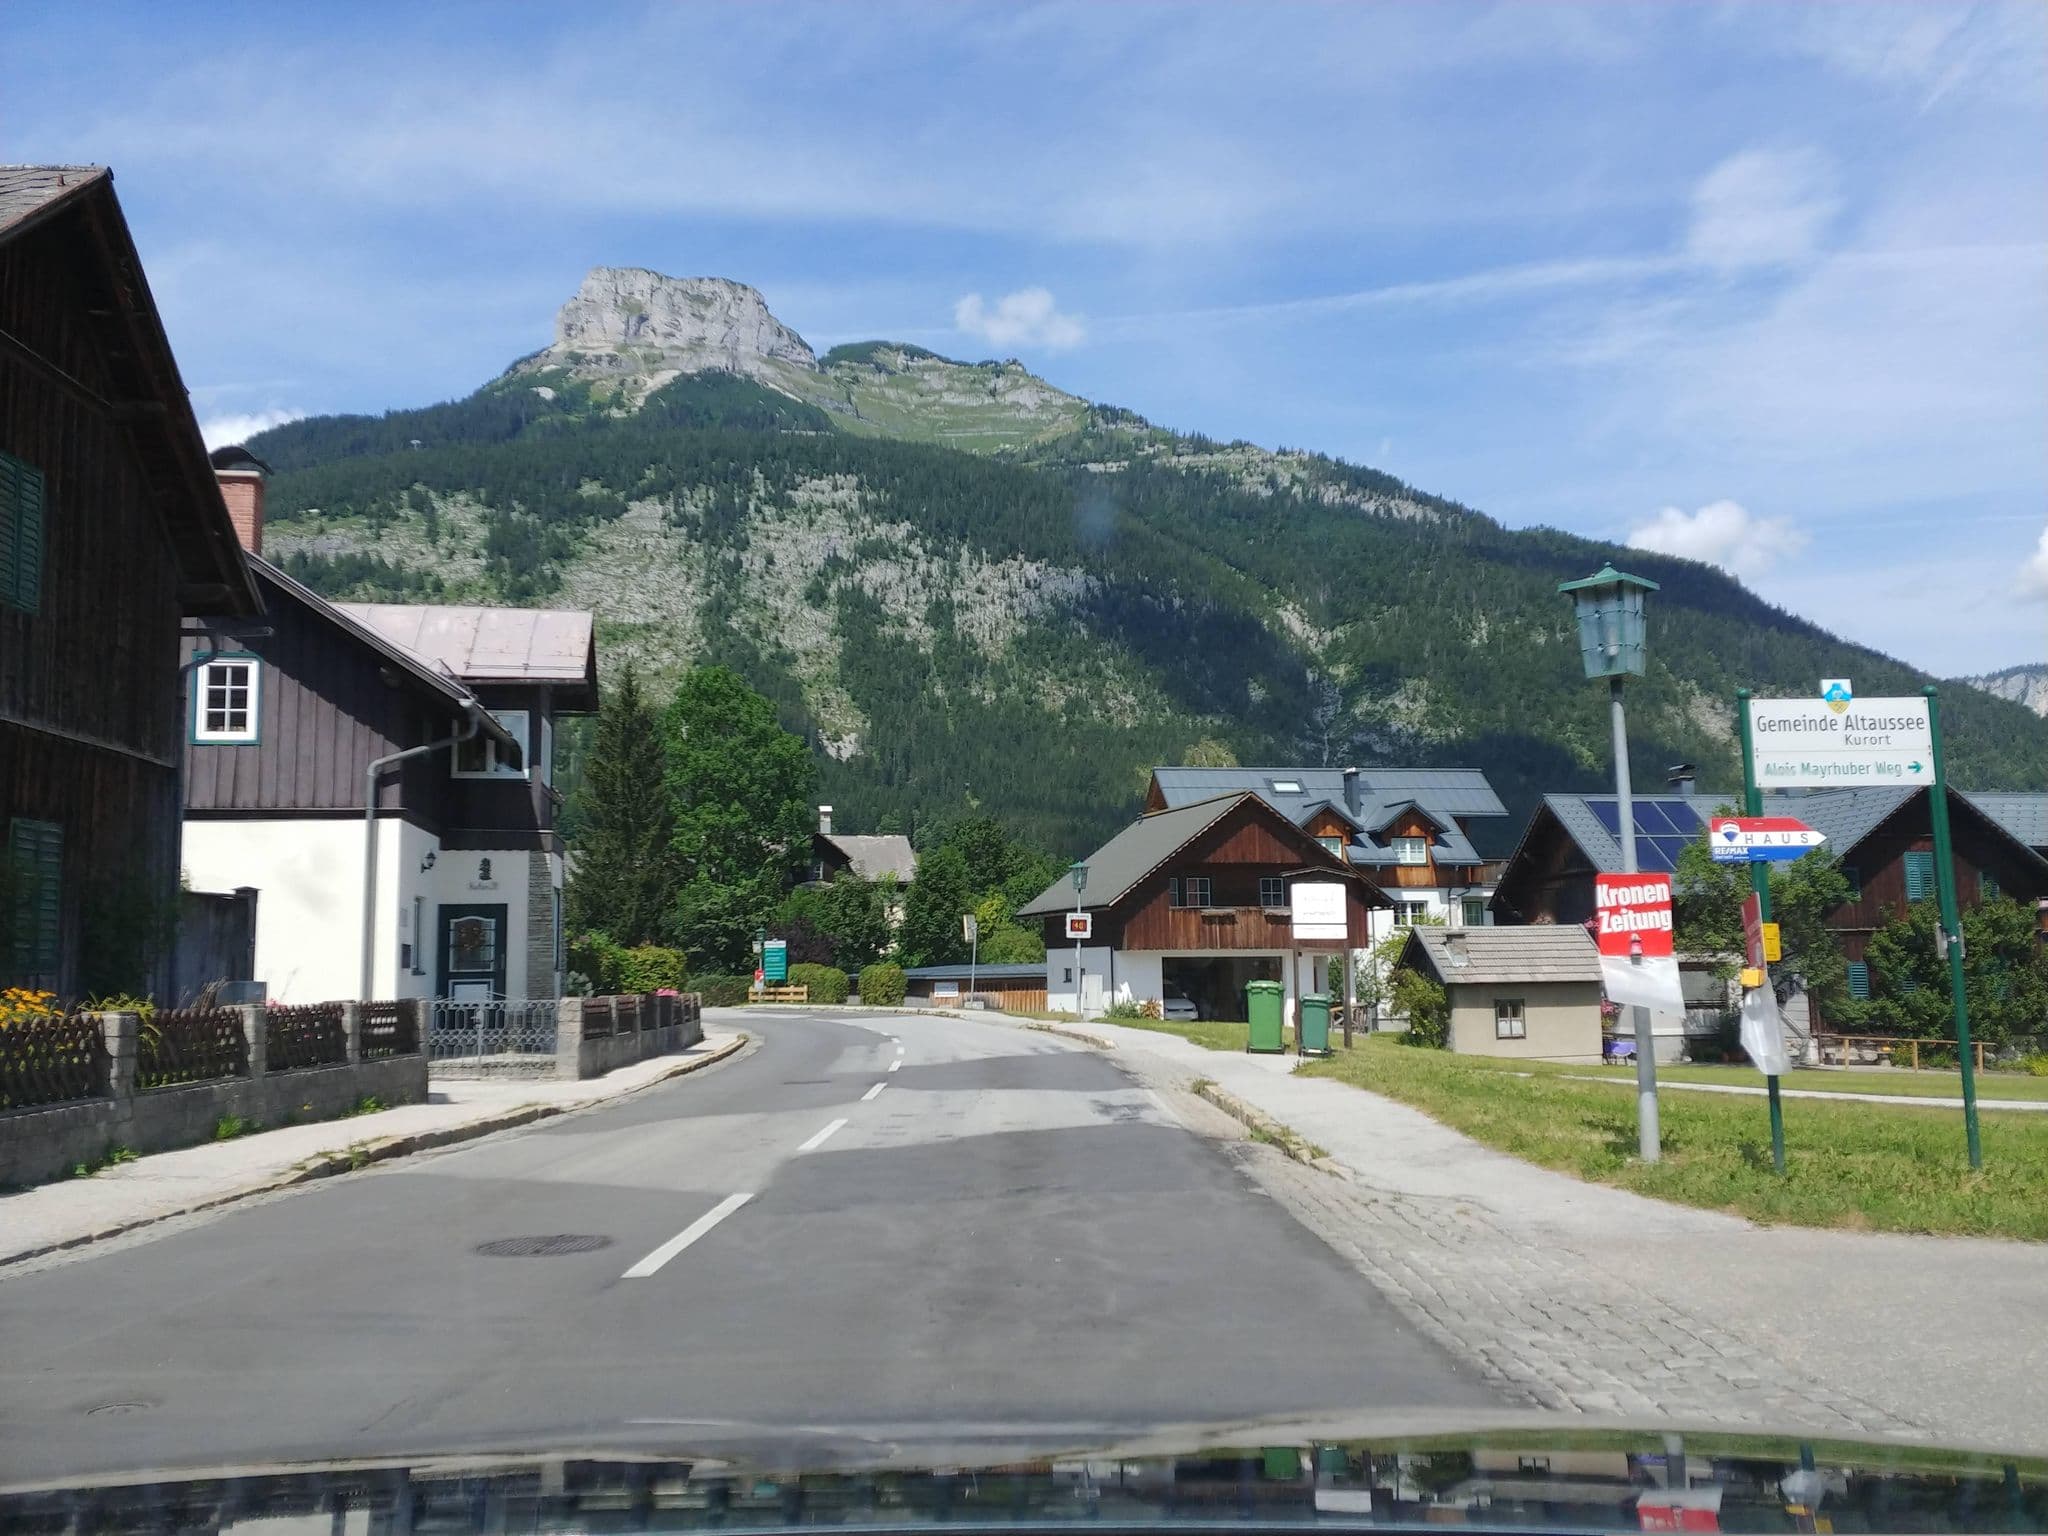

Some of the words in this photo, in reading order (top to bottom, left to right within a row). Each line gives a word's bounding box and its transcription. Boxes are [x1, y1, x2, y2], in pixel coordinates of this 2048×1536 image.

[1757, 714, 1839, 733] Gemeinde
[1844, 714, 1926, 731] Altaussee
[1845, 734, 1892, 746] Kurort
[1764, 762, 1797, 776] Alois
[1801, 761, 1870, 778] Mayrhuber
[1876, 761, 1903, 778] Weg
[1596, 883, 1671, 908] Kronen
[1597, 907, 1673, 934] Zeitung
